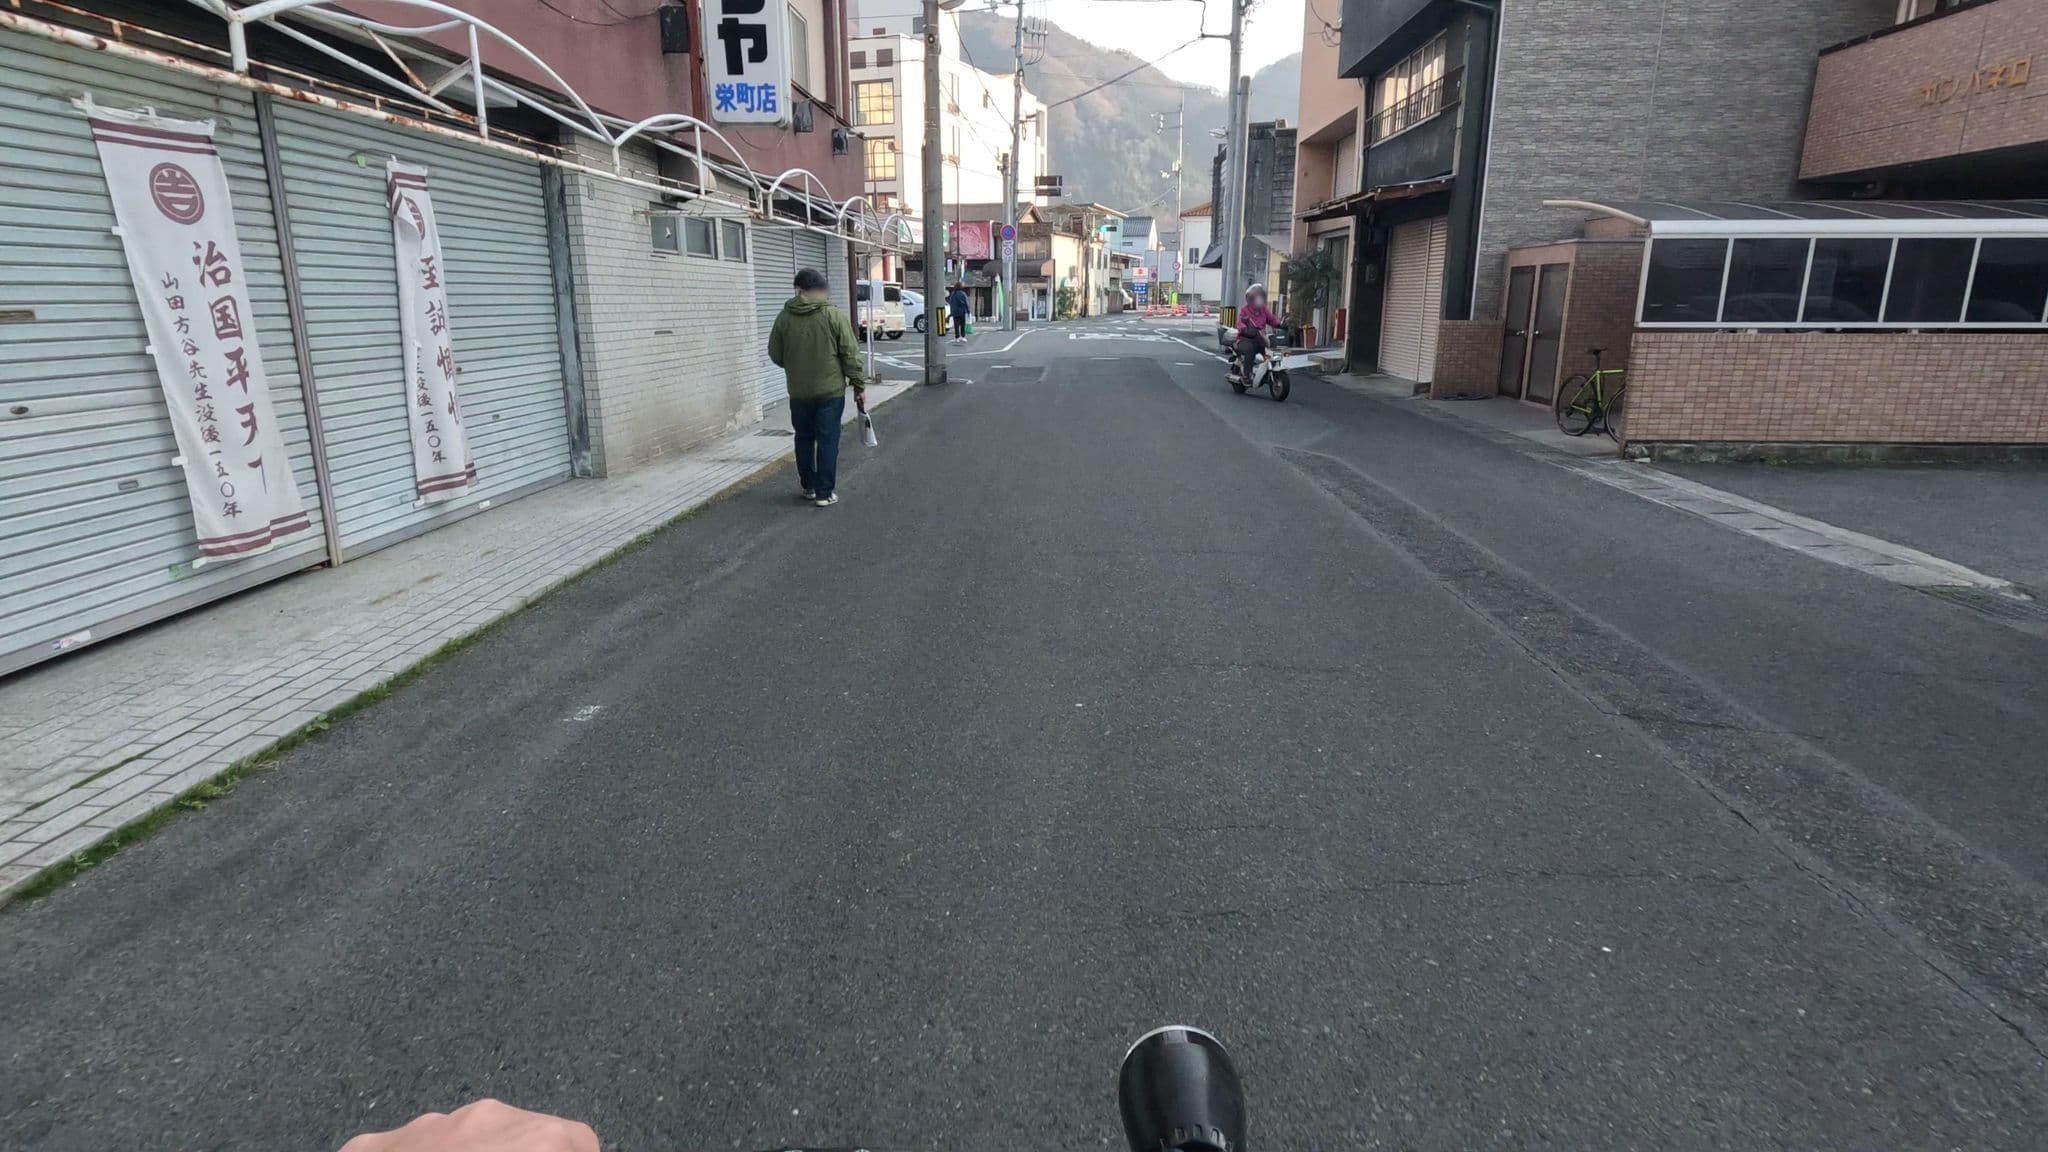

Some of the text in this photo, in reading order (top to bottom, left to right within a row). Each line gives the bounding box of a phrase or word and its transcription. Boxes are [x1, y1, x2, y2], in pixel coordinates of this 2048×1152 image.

[717, 0, 768, 75] ヤ
[715, 82, 777, 113] 栄町店
